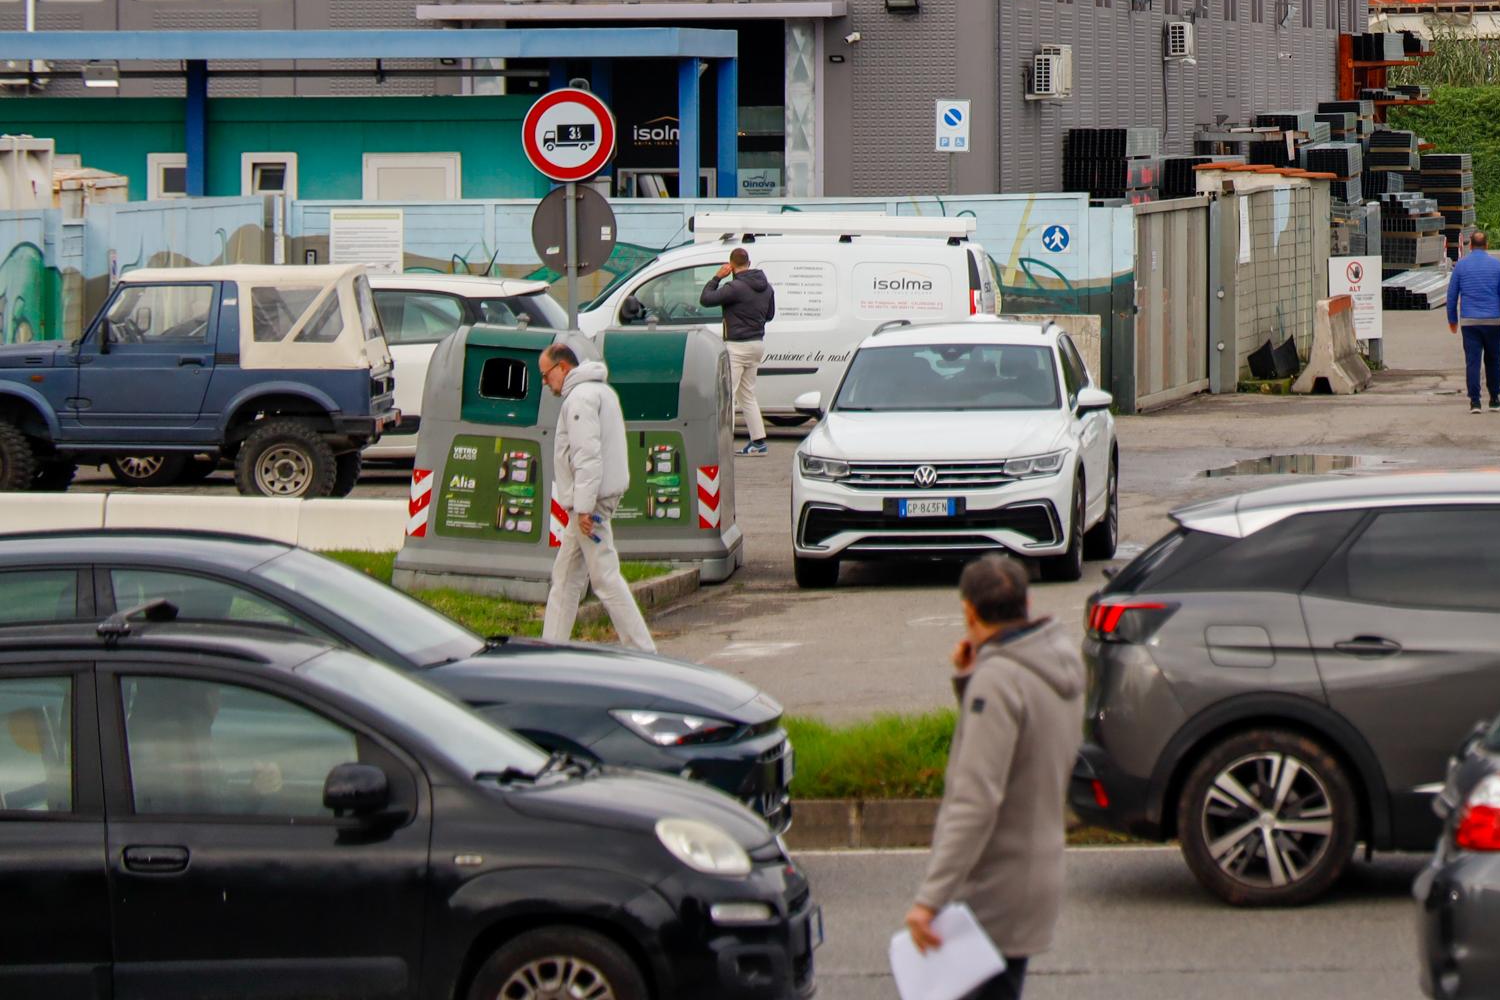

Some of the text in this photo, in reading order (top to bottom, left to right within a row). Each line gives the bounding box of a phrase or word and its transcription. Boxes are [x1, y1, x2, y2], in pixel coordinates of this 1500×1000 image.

[633, 125, 679, 141] isolm
[873, 277, 932, 291] isolma
[762, 351, 805, 364] passione
[454, 446, 478, 455] VETRO
[450, 475, 476, 489] Alia
